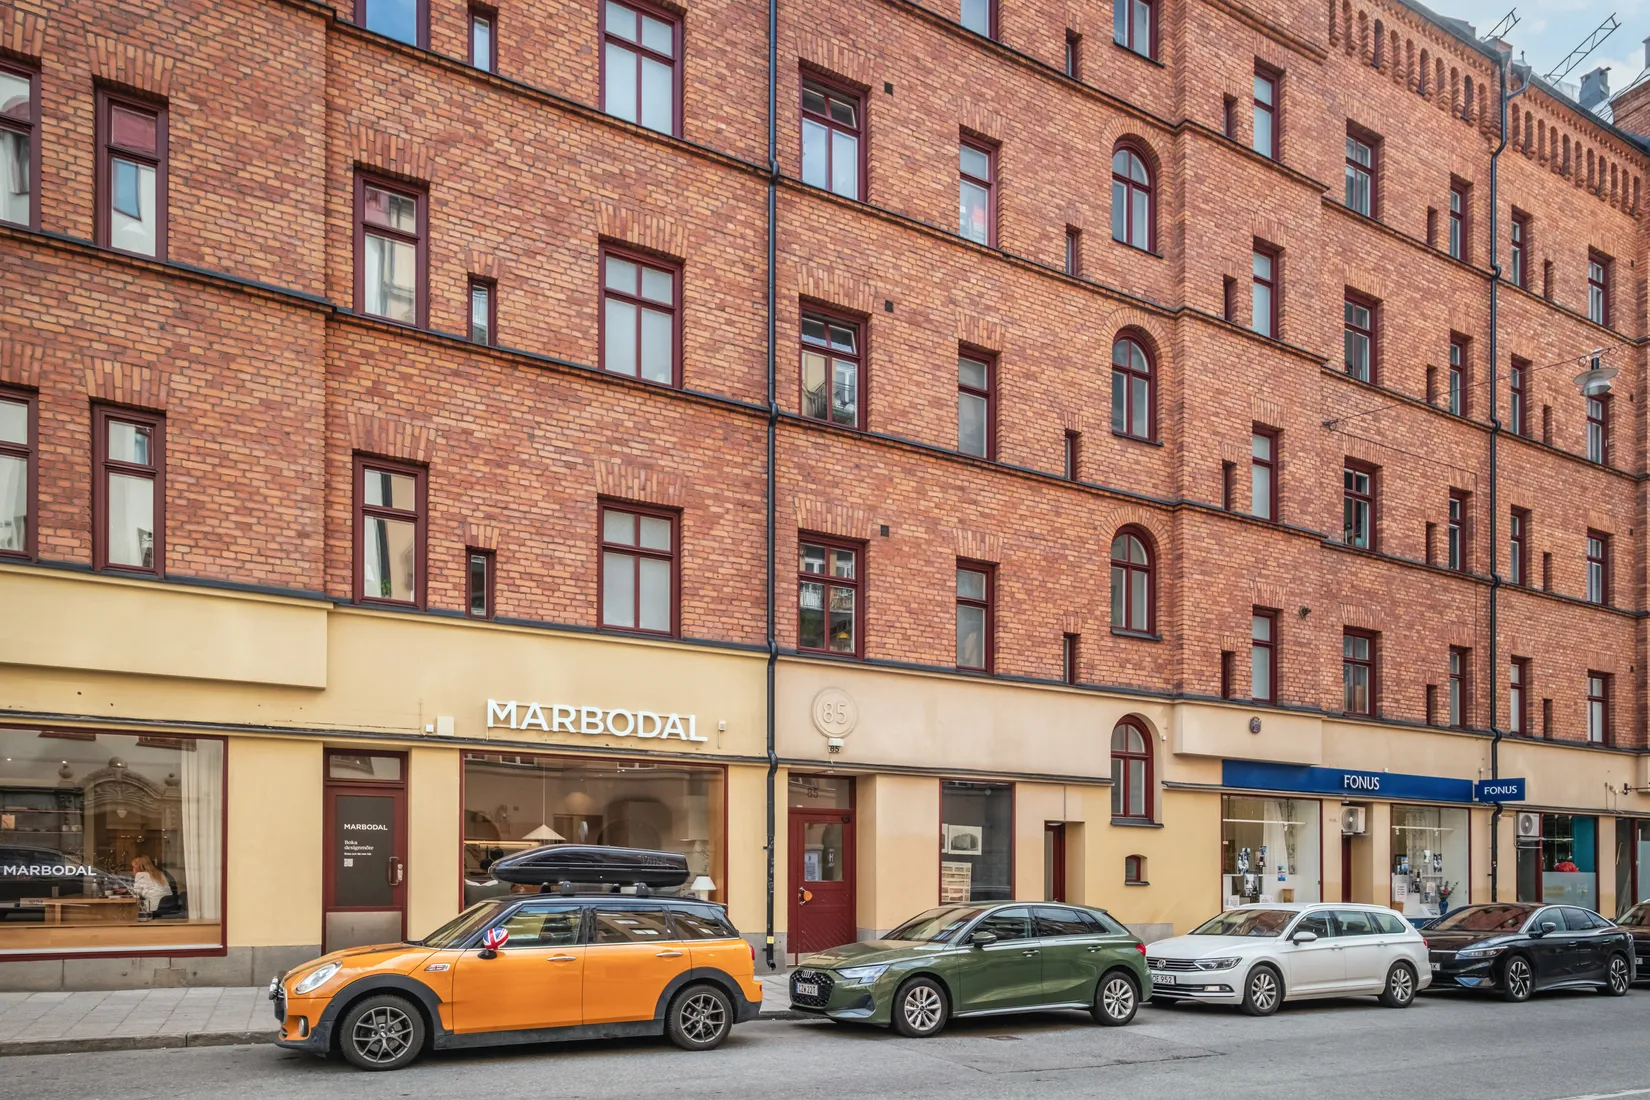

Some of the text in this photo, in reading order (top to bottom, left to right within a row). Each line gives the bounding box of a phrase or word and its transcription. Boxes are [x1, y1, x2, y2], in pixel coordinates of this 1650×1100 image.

[823, 701, 847, 724] 85
[488, 699, 708, 742] MARBODAL
[1344, 775, 1380, 790] FONUS
[807, 787, 819, 798] 85
[1484, 786, 1518, 795] FONUS
[3, 865, 97, 876] MARBODAL
